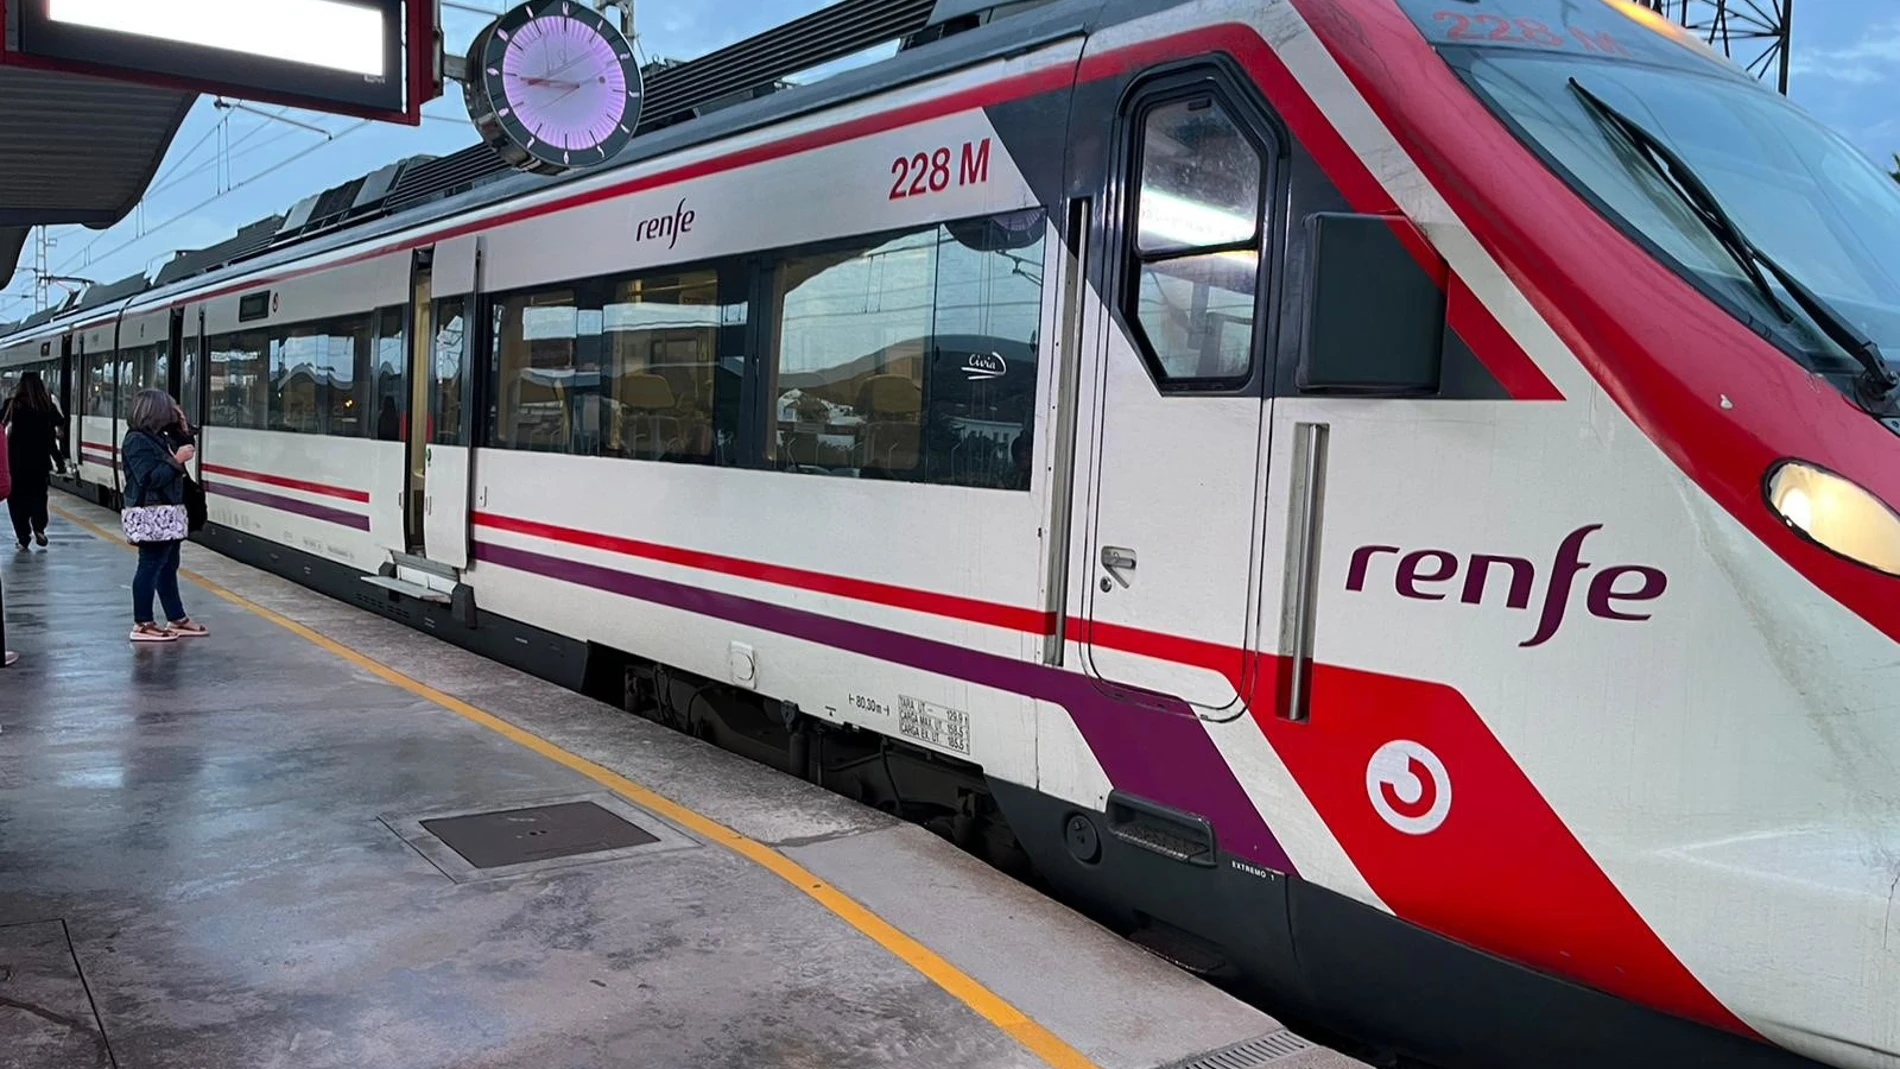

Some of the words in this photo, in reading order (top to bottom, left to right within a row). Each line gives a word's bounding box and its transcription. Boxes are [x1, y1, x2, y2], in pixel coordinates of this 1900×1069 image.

[1433, 11, 1565, 47] 228
[889, 147, 951, 200] 228
[959, 137, 991, 187] M
[636, 197, 695, 250] renfe
[969, 353, 996, 370] Civia
[1345, 523, 1668, 648] renfe
[1232, 860, 1267, 879] EXTREMO
